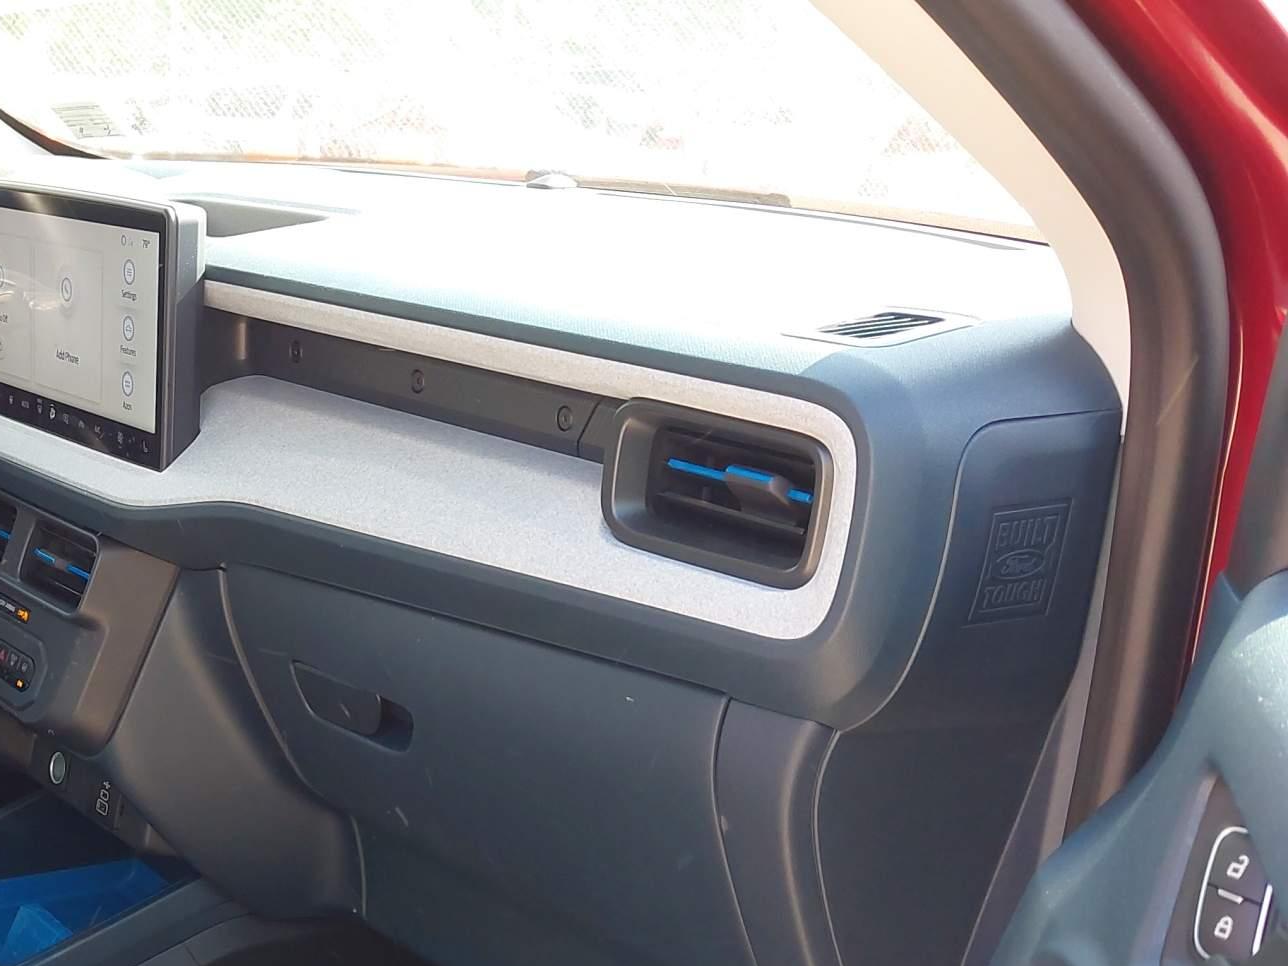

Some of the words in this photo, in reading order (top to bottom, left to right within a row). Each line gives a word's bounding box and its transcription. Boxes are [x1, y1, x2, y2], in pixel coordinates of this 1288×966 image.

[56, 348, 65, 361] Add
[65, 351, 80, 366] Phone
[981, 578, 1048, 609] TOUGH
